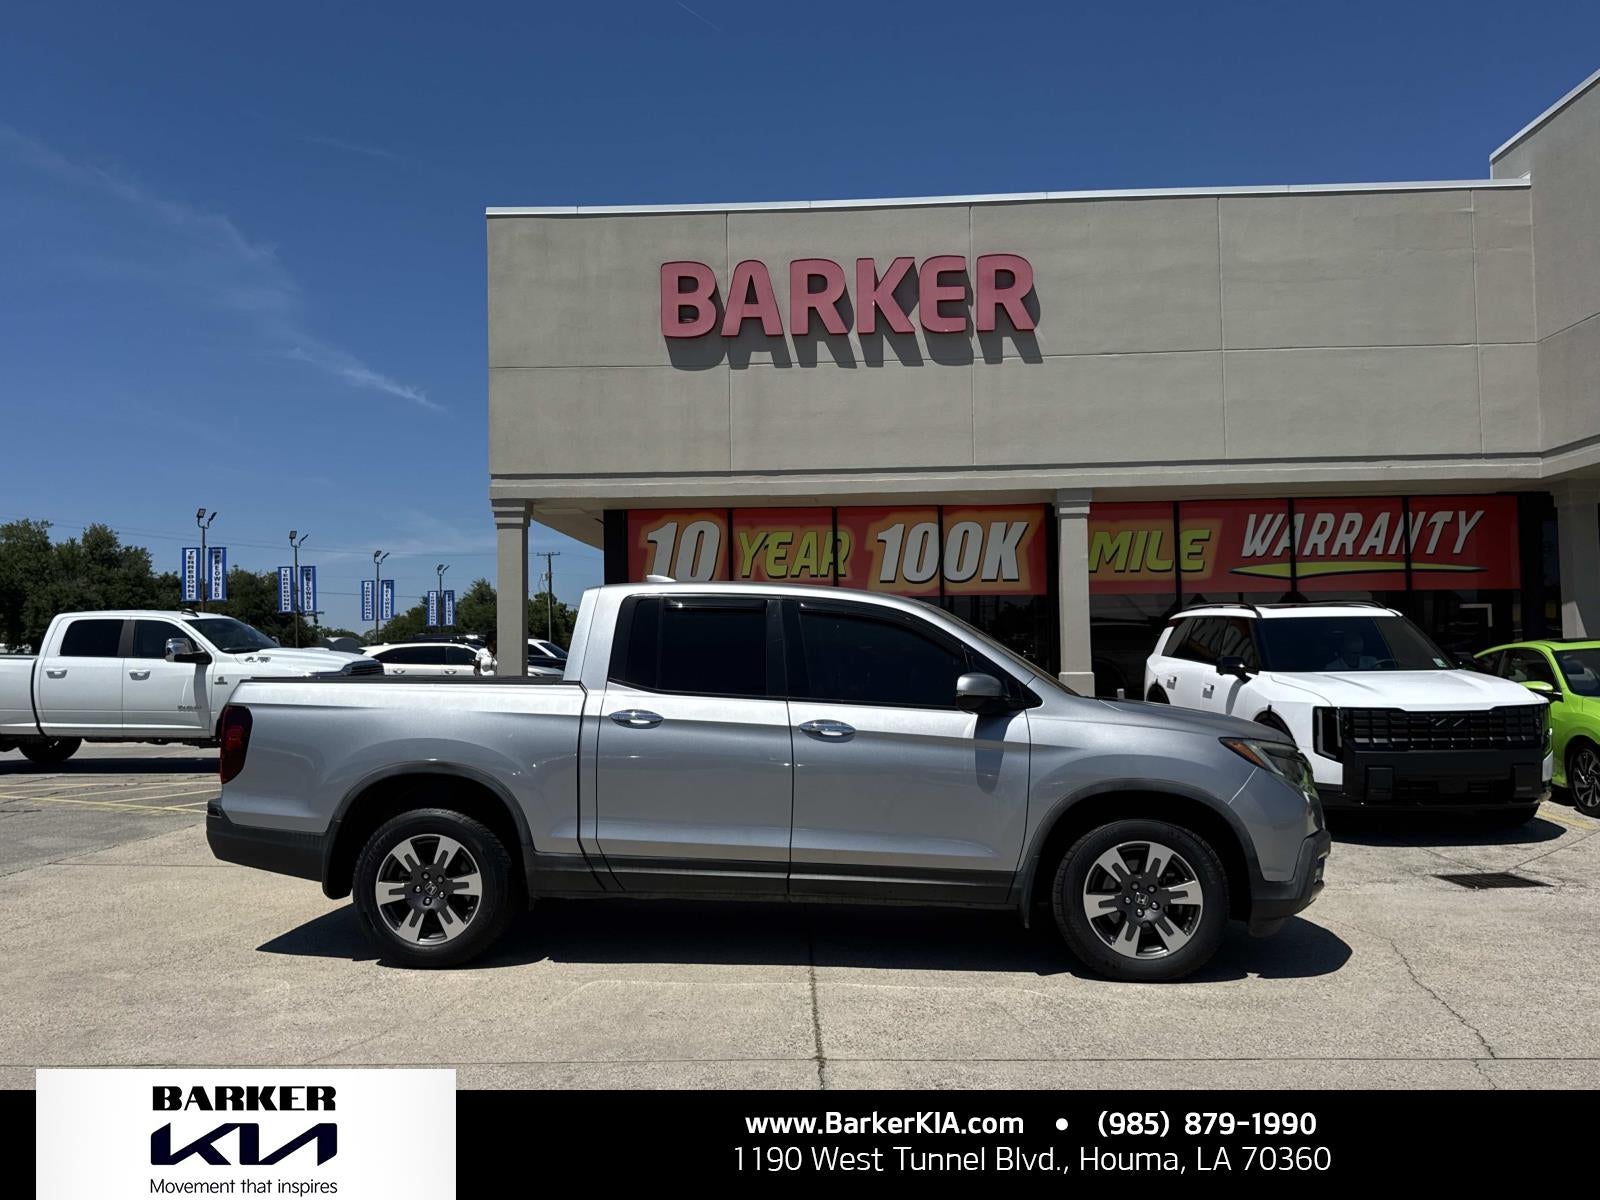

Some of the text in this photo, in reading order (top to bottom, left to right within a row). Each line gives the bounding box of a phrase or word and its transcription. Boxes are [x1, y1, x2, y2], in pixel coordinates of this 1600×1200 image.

[660, 253, 1036, 338] BARKER
[647, 510, 1485, 584] 10 YEAR 100K MILE WARRANTY
